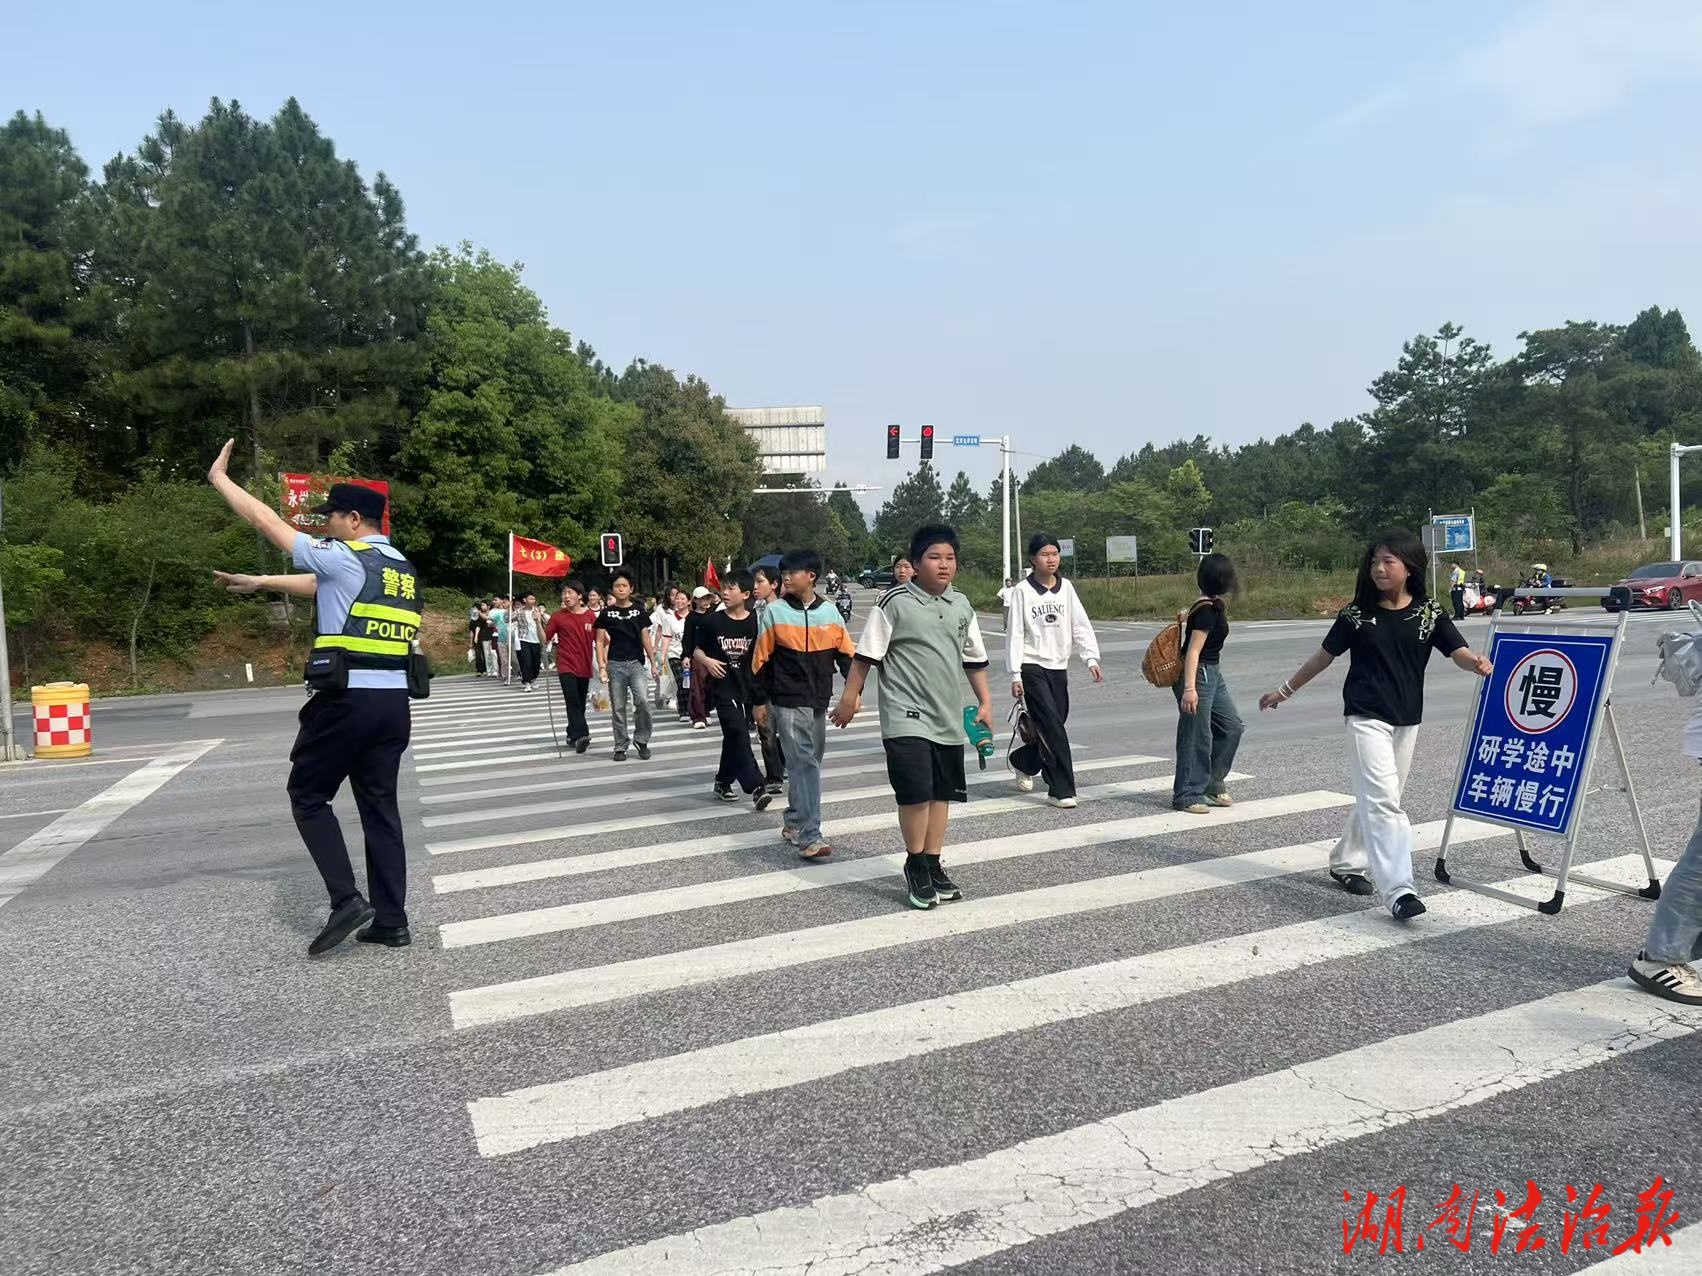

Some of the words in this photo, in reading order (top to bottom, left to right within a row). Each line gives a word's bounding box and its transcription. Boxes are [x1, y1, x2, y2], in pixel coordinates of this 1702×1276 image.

[382, 567, 415, 600] 警察
[1031, 604, 1065, 619] SALIENC
[365, 620, 416, 641] POLIC
[1518, 664, 1564, 719] 慢
[1478, 735, 1575, 777] 研学途中
[1467, 772, 1565, 818] 车辆慢行
